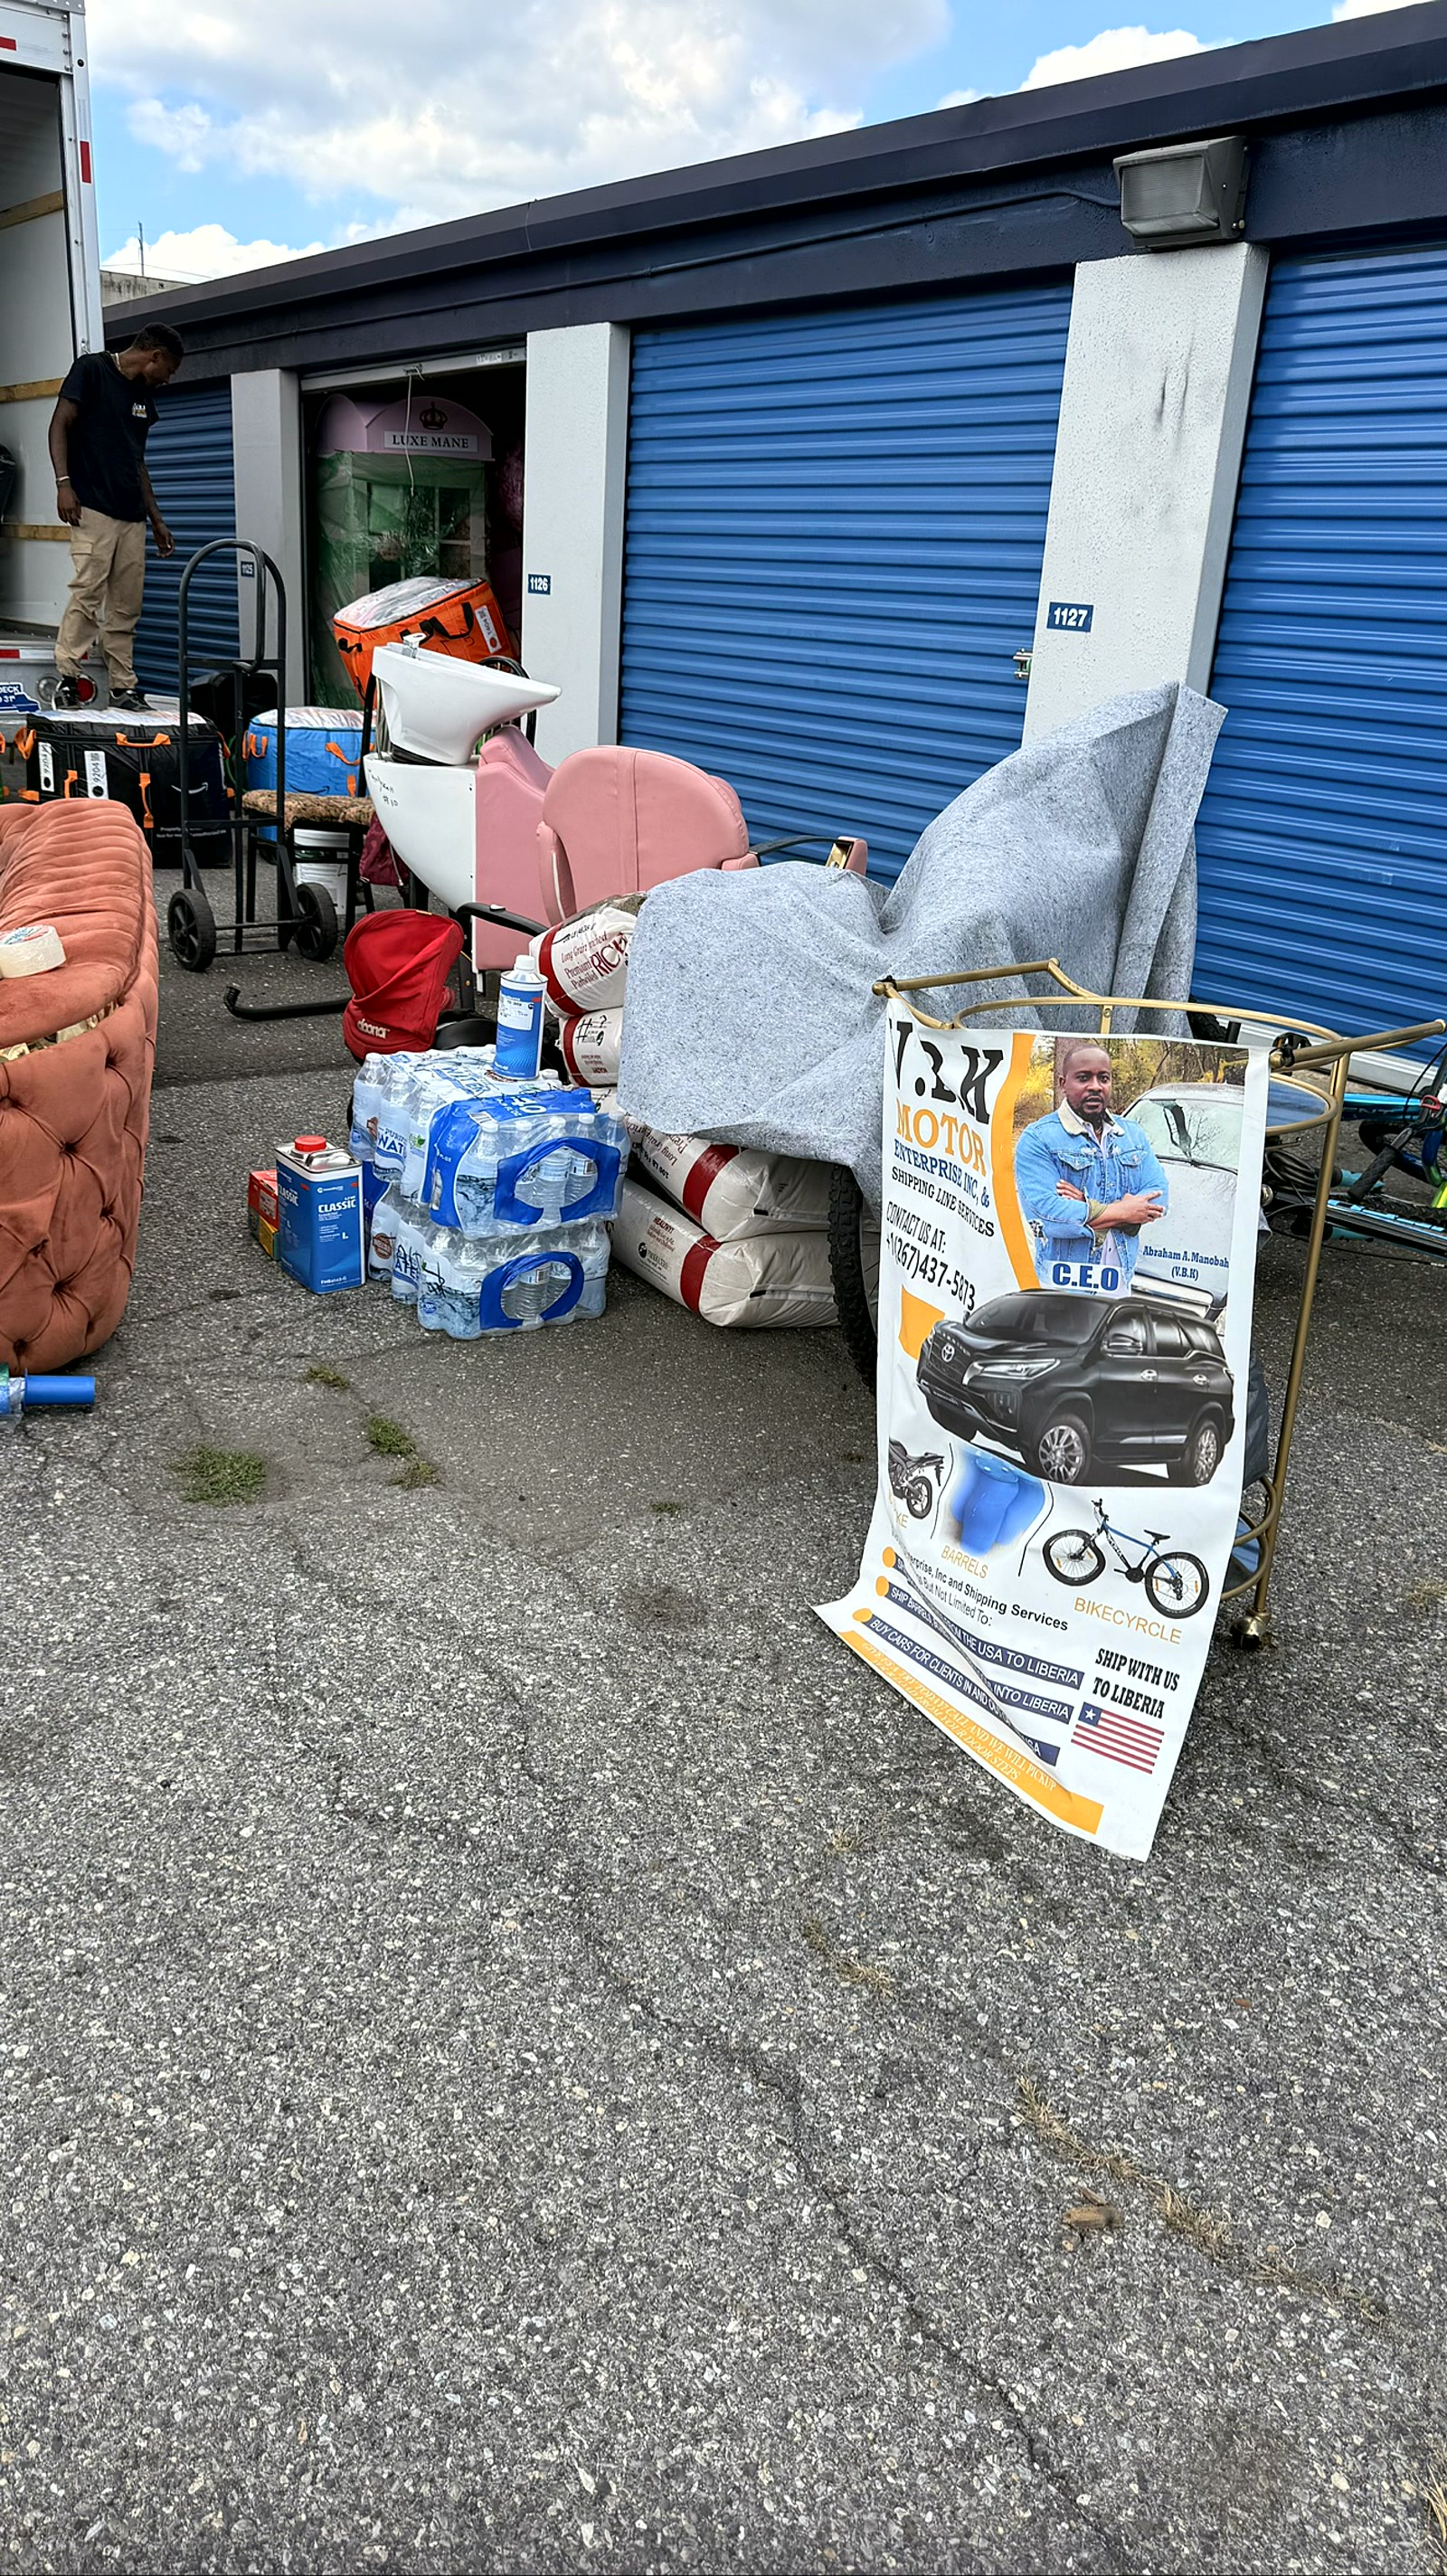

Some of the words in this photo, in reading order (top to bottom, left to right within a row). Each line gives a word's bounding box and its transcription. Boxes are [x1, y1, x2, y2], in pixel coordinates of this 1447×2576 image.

[392, 434, 428, 446] LUXE
[431, 437, 469, 449] MANE
[530, 576, 548, 592] 1126
[1054, 607, 1088, 627] 1127
[0, 686, 19, 694] ECK
[563, 961, 593, 979] Premium
[660, 1147, 678, 1166] Long
[895, 1097, 987, 1178] MOTOR
[894, 1138, 963, 1188] ENTERPRISE
[963, 1172, 979, 1206] INC,
[980, 1186, 990, 1208] &
[318, 1198, 356, 1214] CLASSIC
[892, 1166, 935, 1199] SHIPPING
[935, 1187, 957, 1211] LINE
[957, 1198, 995, 1237] SERVICES
[886, 1200, 921, 1237] CONTACT
[919, 1219, 932, 1245] US
[930, 1227, 946, 1254] AT:
[886, 1231, 976, 1312] +1(267)437-5873
[1052, 1263, 1119, 1292] C.E.O
[1142, 1245, 1182, 1261] Abraham
[1182, 1253, 1191, 1263] A.
[1191, 1255, 1230, 1268] Manobah
[1171, 1266, 1199, 1282] (V.B.K)
[941, 1545, 989, 1579] BARRELS
[890, 1586, 909, 1604] SHIP
[934, 1569, 948, 1586] Inc
[949, 1577, 963, 1593] and
[963, 1583, 1008, 1615] Shipping
[1010, 1603, 1069, 1632] Services
[934, 1582, 948, 1605] Not
[949, 1592, 977, 1619] Limited
[977, 1608, 993, 1627] To:
[1073, 1596, 1182, 1644] BIKECYRCLE
[870, 1618, 891, 1635] BUY
[887, 1629, 913, 1651] CARS
[910, 1645, 931, 1665] FOR
[929, 1657, 963, 1687] CLIENTS
[962, 1680, 973, 1696] IN
[972, 1688, 988, 1706] AND
[962, 1632, 978, 1652] THE
[978, 1643, 1004, 1663] USA
[1006, 1651, 1025, 1669] TO
[1026, 1658, 1079, 1686] LIBERIA
[1095, 1648, 1128, 1672] SHIP
[1128, 1658, 1163, 1686] WITH
[1163, 1671, 1180, 1691] US
[994, 1684, 1021, 1703] INTO
[1022, 1693, 1071, 1719] LIBERIA
[1092, 1677, 1111, 1698] TO
[1111, 1684, 1165, 1719] LIBERIA
[938, 1713, 965, 1738] YOUR
[964, 1734, 993, 1760] DOOR
[990, 1754, 1020, 1781] STEPS
[946, 1705, 969, 1727] CALL
[968, 1722, 990, 1743] AND
[987, 1737, 1006, 1755] WE
[1002, 1746, 1028, 1770] WILL
[1026, 1760, 1057, 1792] PICKUP
